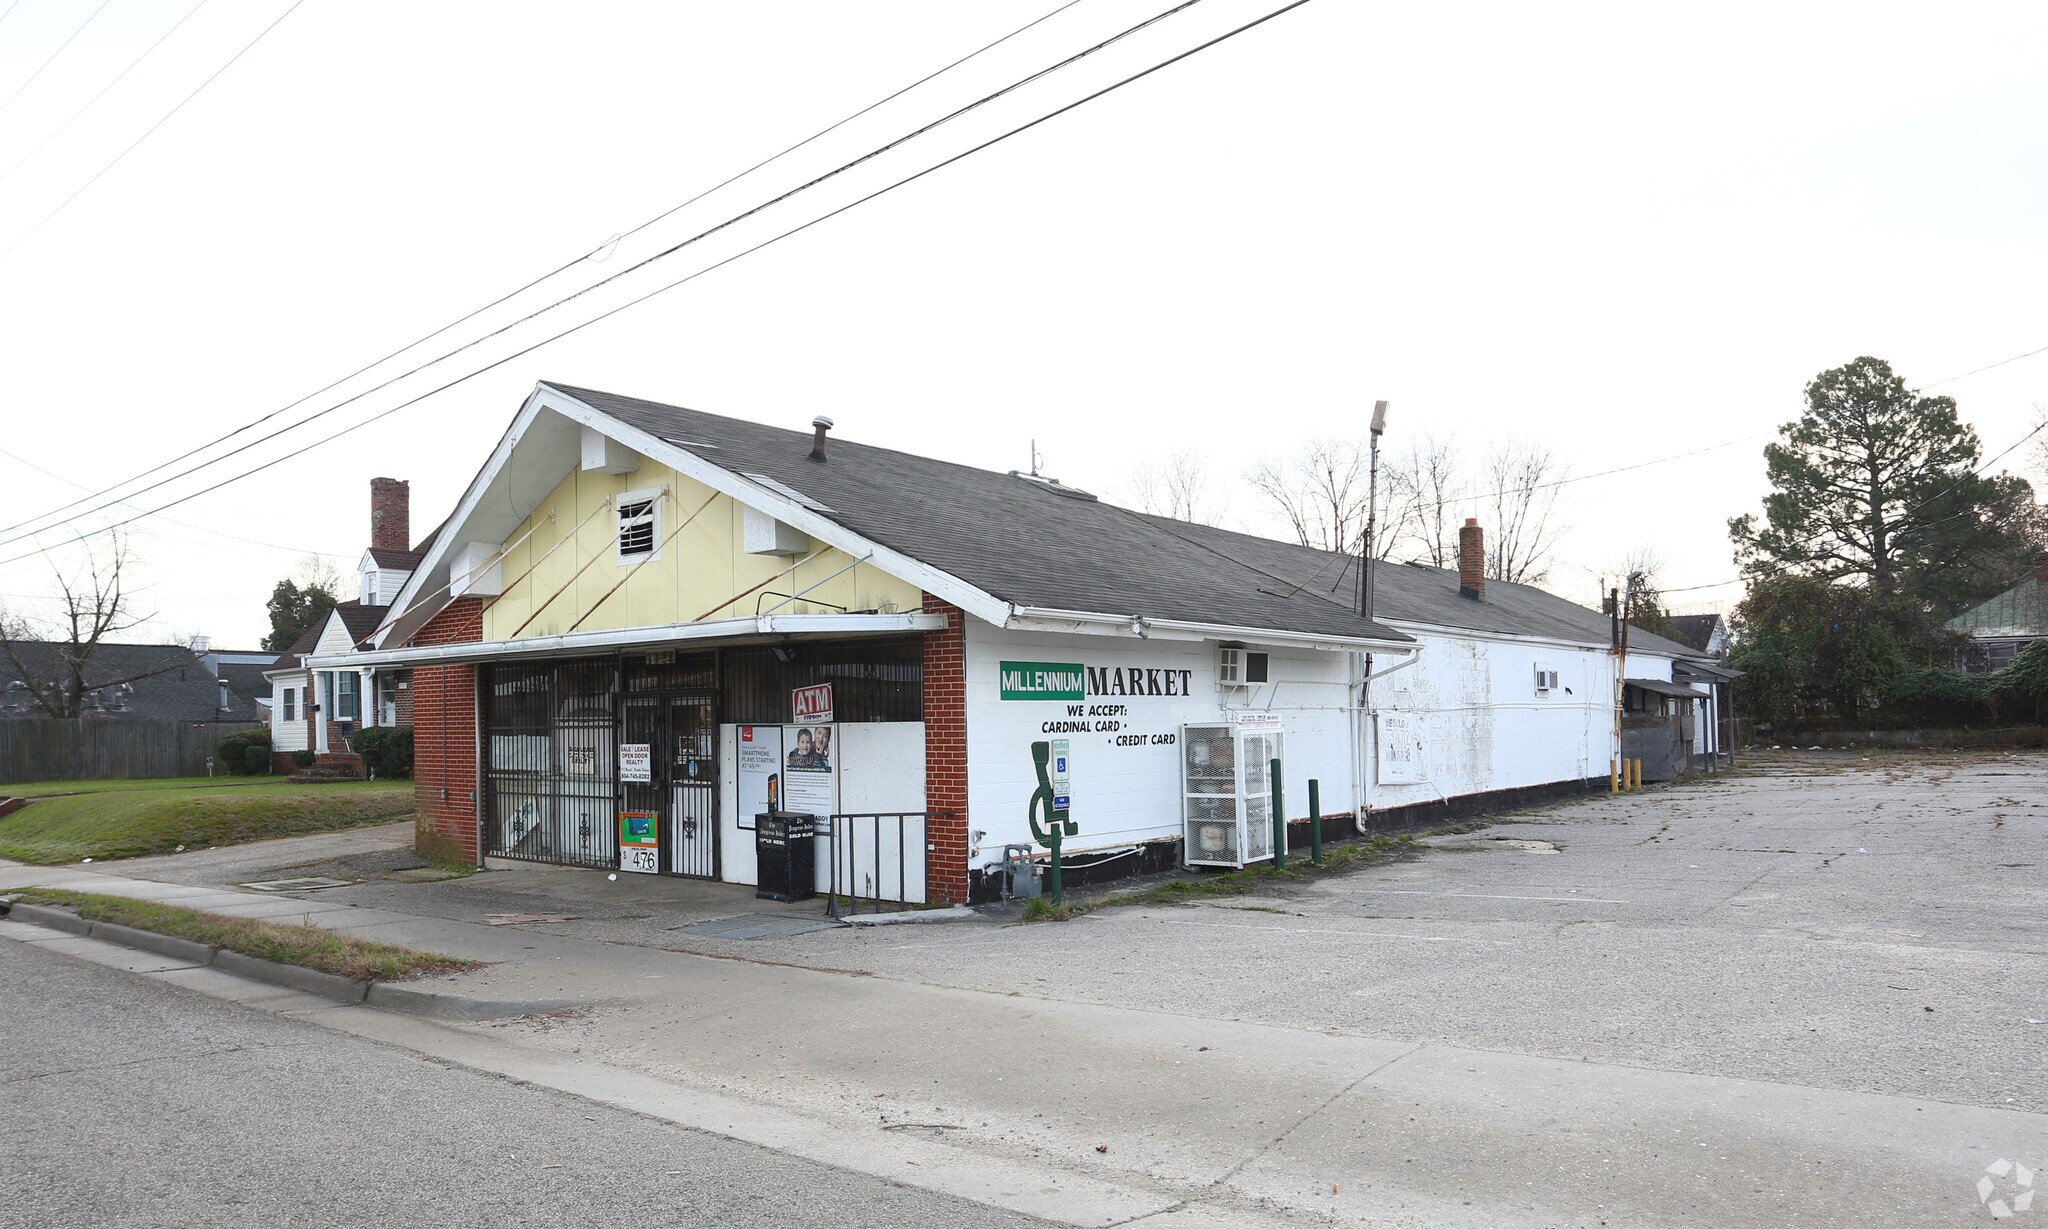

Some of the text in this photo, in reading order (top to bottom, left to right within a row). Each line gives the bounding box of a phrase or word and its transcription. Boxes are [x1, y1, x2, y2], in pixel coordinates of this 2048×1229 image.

[1002, 666, 1192, 696] MILLENNIUM MARKET
[796, 687, 829, 714] ATM
[1067, 705, 1127, 717] WE ACCEPT:
[1041, 720, 1120, 734] CARDINAL CARD
[1116, 733, 1176, 747] CREDIT CARD
